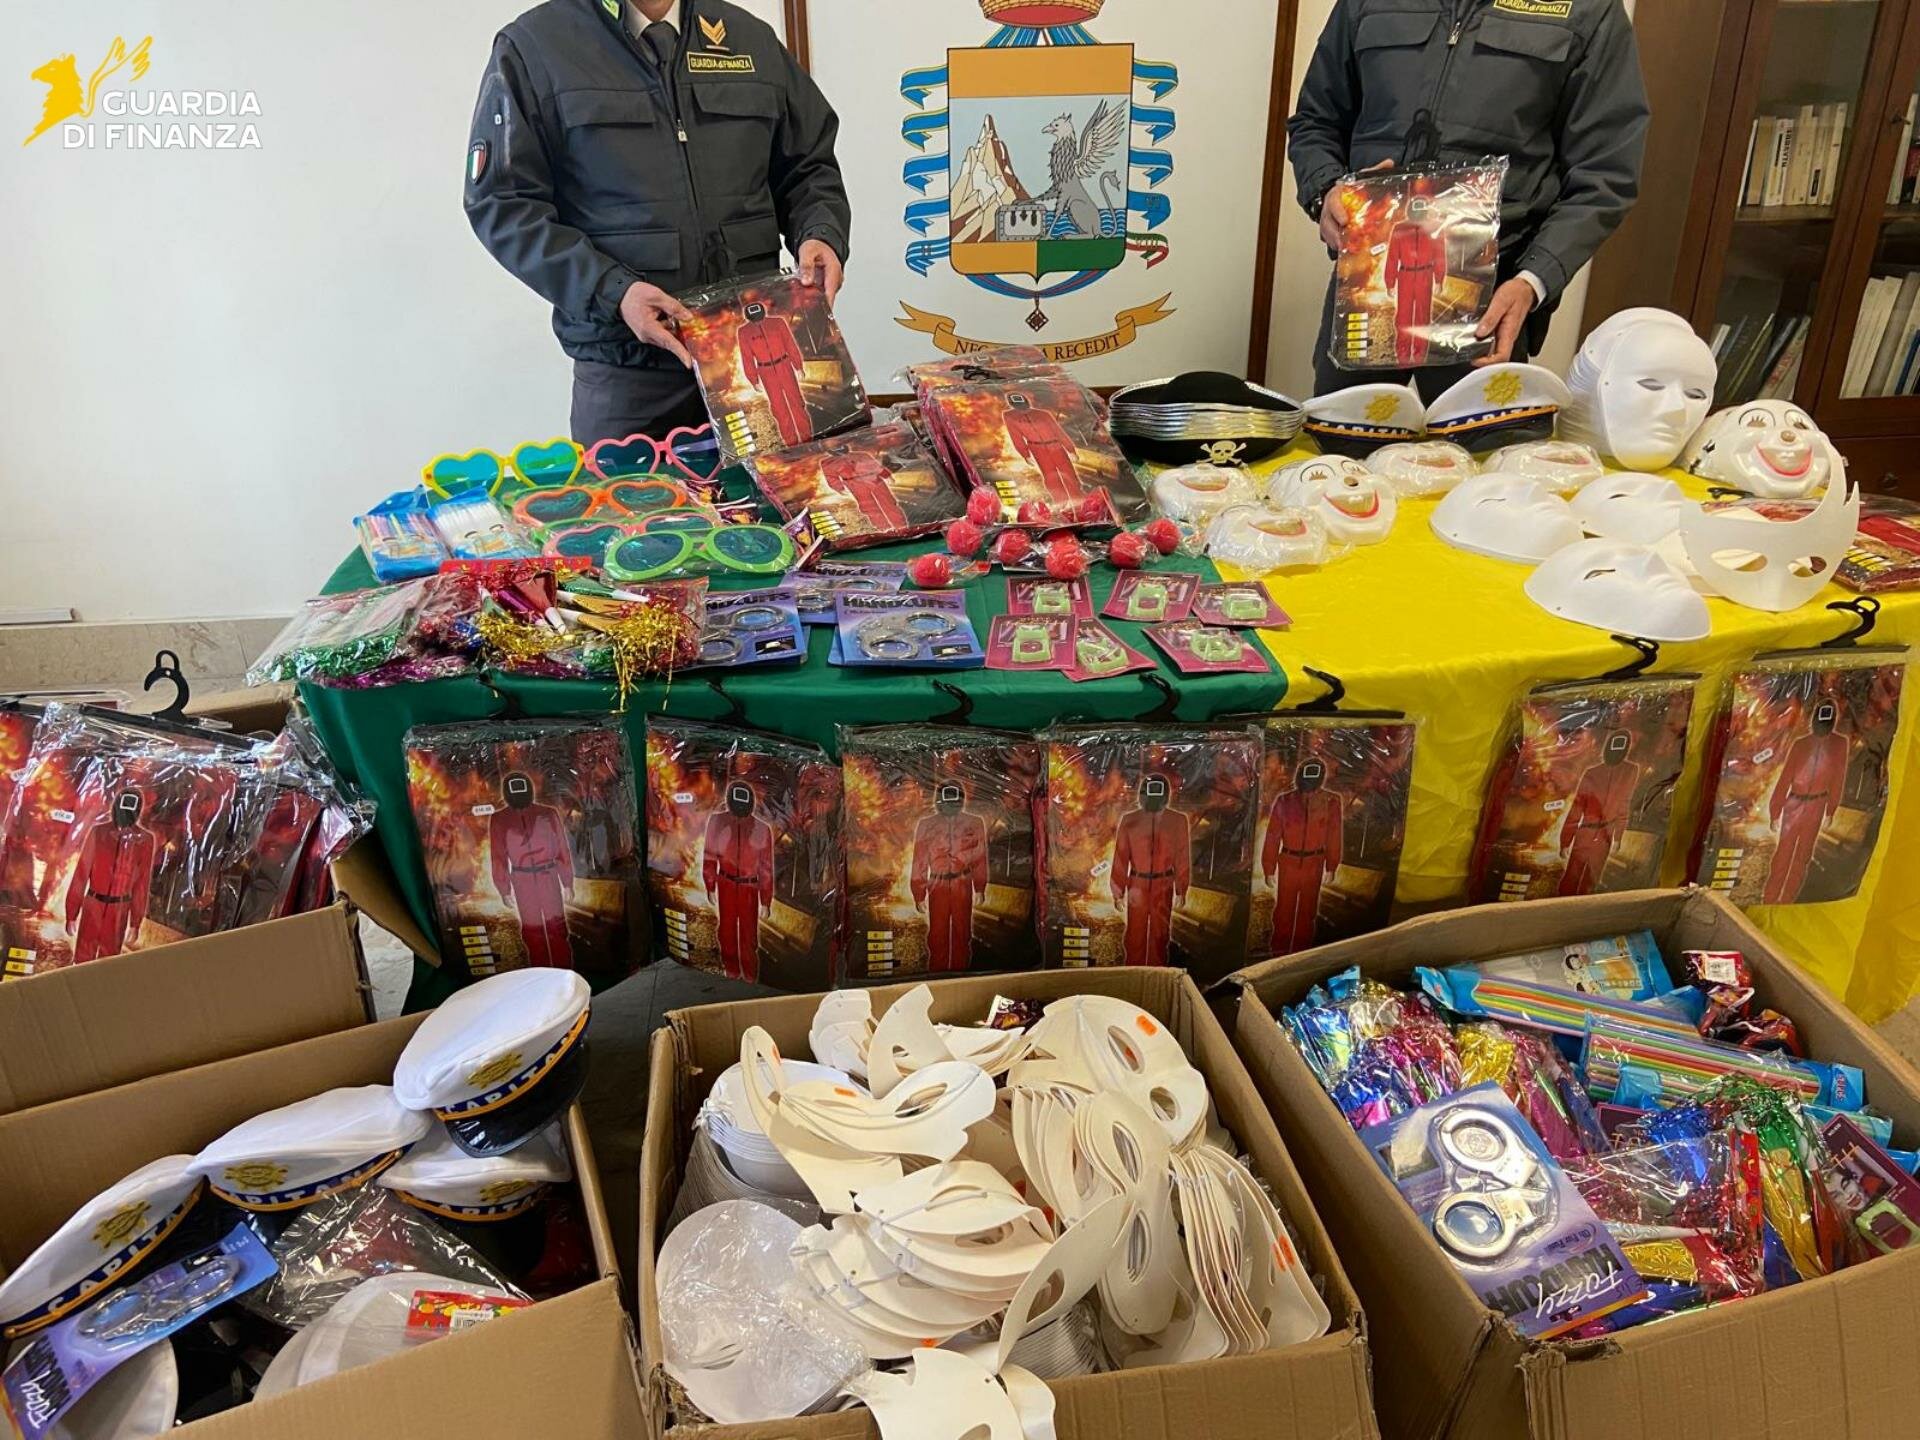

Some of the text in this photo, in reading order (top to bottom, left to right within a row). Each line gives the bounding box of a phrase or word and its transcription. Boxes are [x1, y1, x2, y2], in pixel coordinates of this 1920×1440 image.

[1055, 333, 1121, 361] RECEDIT
[1535, 1260, 1624, 1319] Fuzzy
[20, 1369, 57, 1429] Fuzzy
